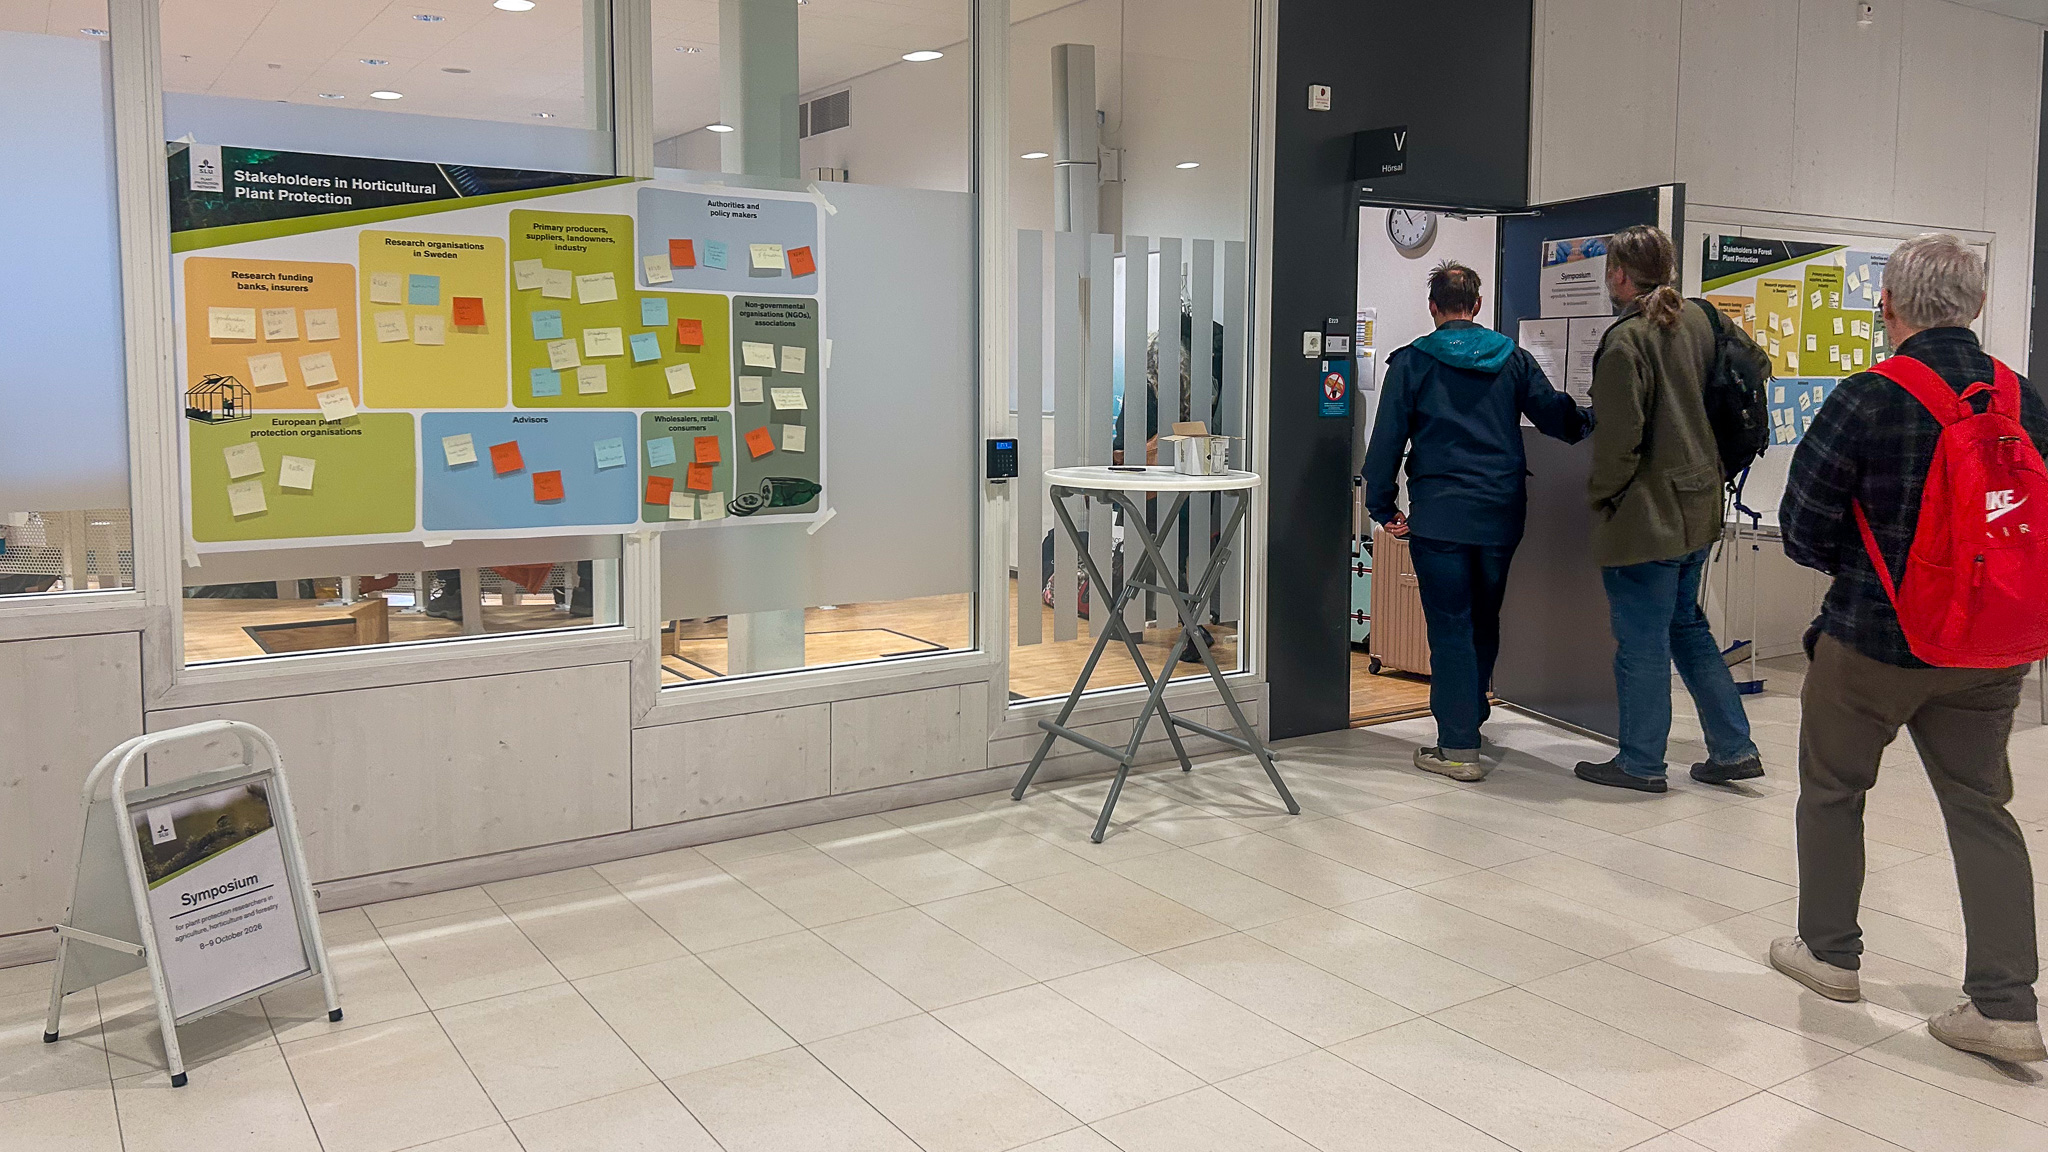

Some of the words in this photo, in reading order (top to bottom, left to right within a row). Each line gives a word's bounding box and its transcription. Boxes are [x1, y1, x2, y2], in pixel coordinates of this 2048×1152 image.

[1393, 131, 1406, 151] V
[1381, 163, 1403, 173] Hörsal
[234, 169, 331, 188] Stakeholders
[334, 175, 348, 189] in
[351, 178, 437, 195] Horticultural
[235, 186, 275, 201] Plant
[278, 190, 353, 206] Protection
[707, 199, 744, 210] Authorities
[746, 201, 760, 211] and
[710, 209, 730, 219] policy
[731, 210, 758, 220] makers
[533, 223, 564, 235] Primary
[565, 224, 609, 236] producers,
[385, 237, 425, 249] Research
[427, 240, 485, 251] organisations
[526, 232, 565, 244] suppliers,
[566, 234, 616, 245] landowners,
[554, 243, 588, 253] industry
[413, 249, 422, 258] in
[424, 250, 458, 260] Sweden
[231, 271, 276, 282] Research
[278, 273, 314, 284] funding
[237, 282, 269, 292] banks,
[271, 283, 309, 293] insurers
[744, 301, 806, 311] Non-governmental
[739, 309, 784, 320] organisations
[785, 309, 812, 321] (NGOs),
[754, 318, 796, 328] associations
[271, 418, 316, 429] European
[318, 418, 342, 428] plant
[512, 415, 549, 424] Advisors
[654, 415, 700, 425] Wholesalers,
[700, 415, 720, 424] retail,
[250, 427, 298, 438] protection
[300, 427, 362, 438] organisations
[668, 424, 707, 432] consumers
[181, 873, 259, 906] Symposium
[185, 918, 201, 930] plant
[201, 908, 232, 925] protection
[232, 897, 268, 913] researchers
[174, 926, 209, 943] agriculture,
[209, 915, 243, 931] horticulture
[243, 910, 256, 919] and
[255, 903, 279, 915] forestry
[215, 930, 243, 945] October
